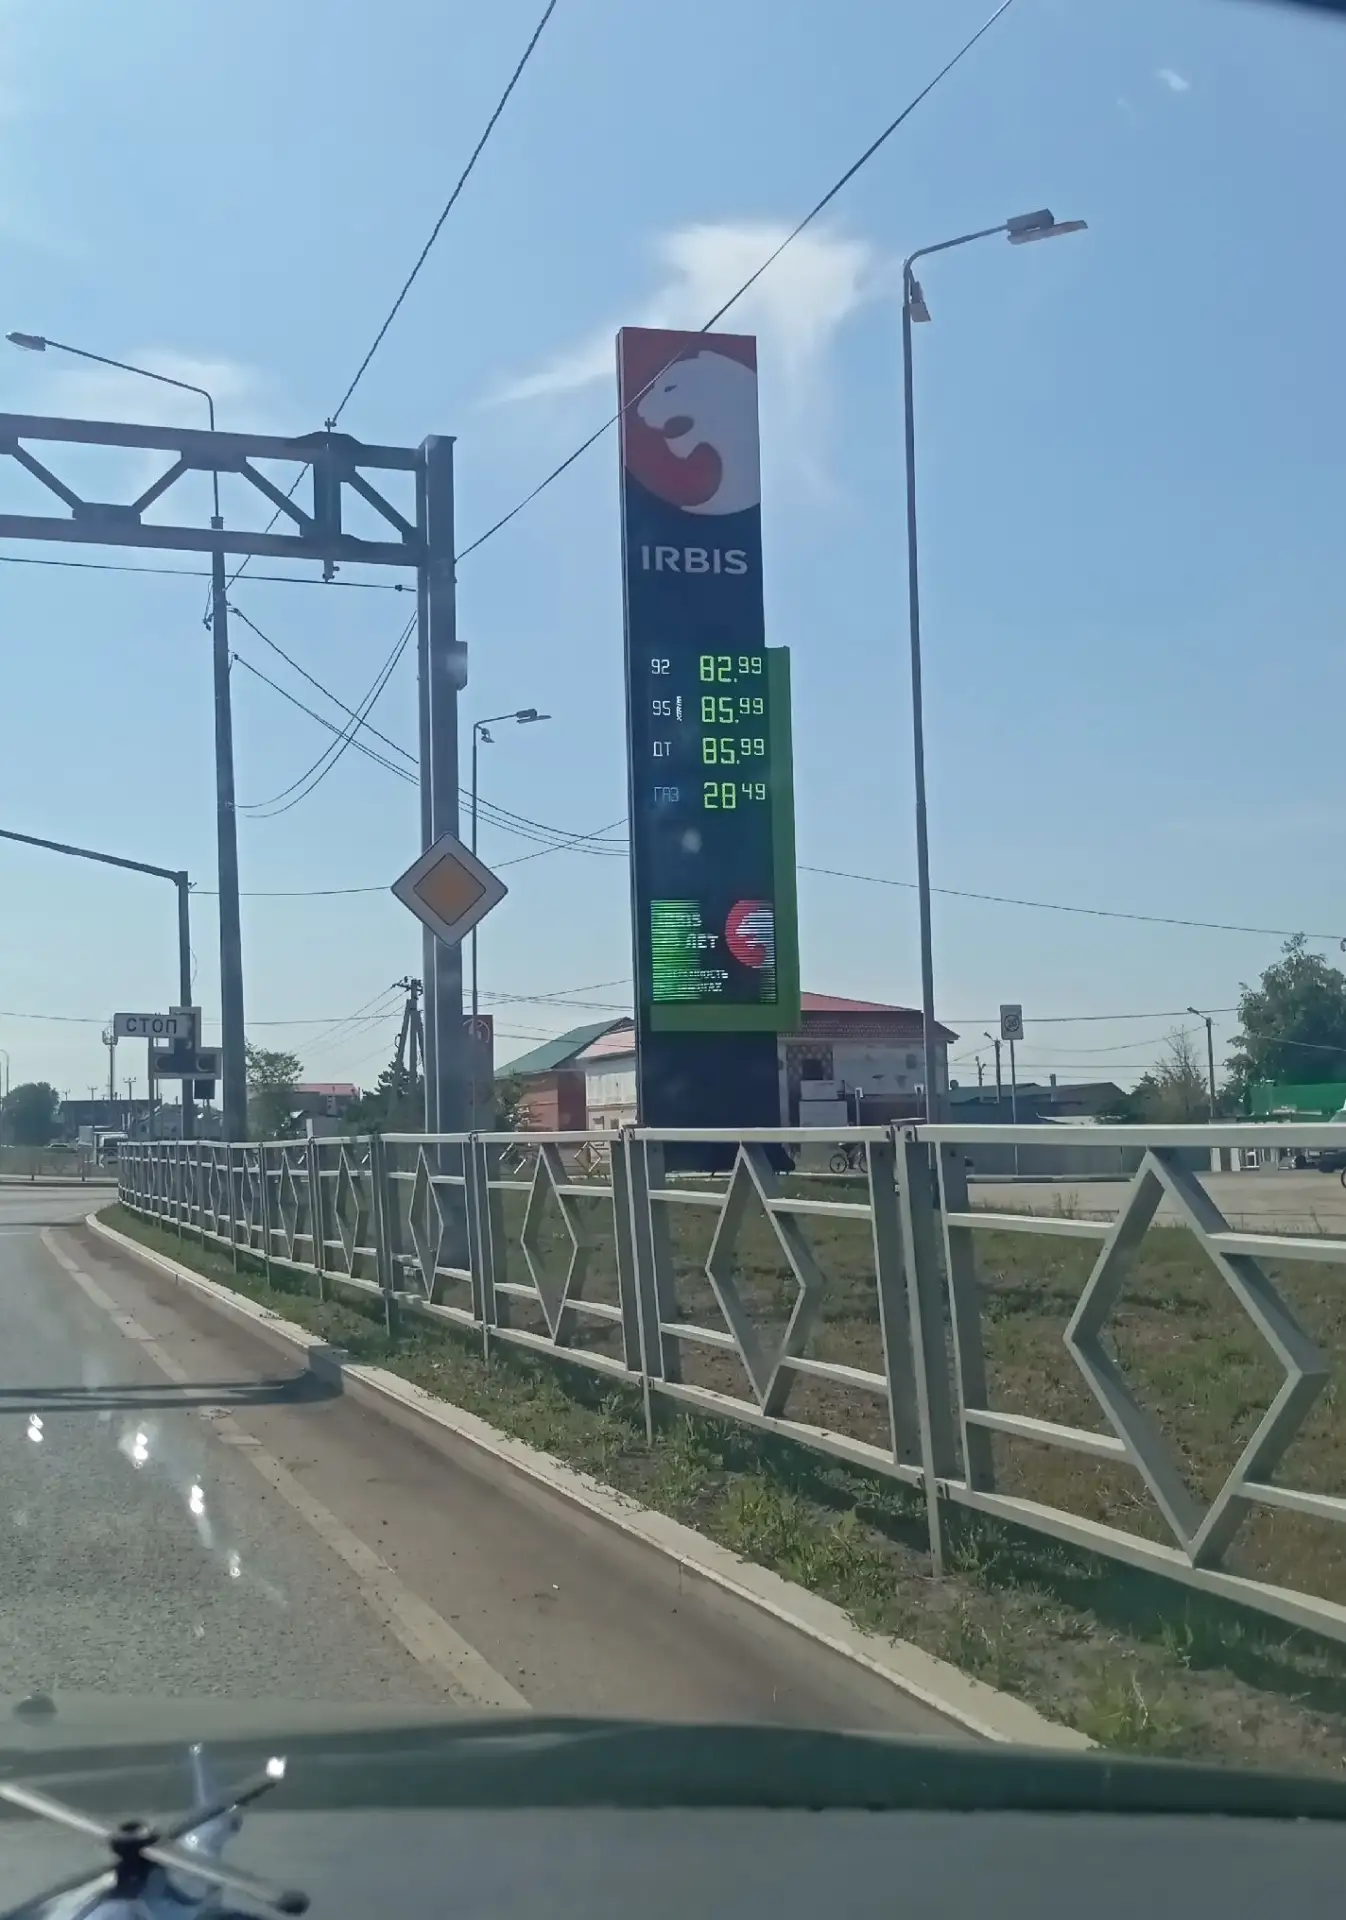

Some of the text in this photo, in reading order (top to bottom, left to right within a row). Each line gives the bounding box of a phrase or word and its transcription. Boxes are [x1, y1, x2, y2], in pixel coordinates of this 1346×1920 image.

[642, 545, 748, 574] IRBIS
[651, 659, 670, 674] 92
[652, 700, 671, 716] 95
[653, 741, 672, 757] ДТ
[654, 786, 680, 802] ГАЗ
[126, 1017, 177, 1034] СТОП
